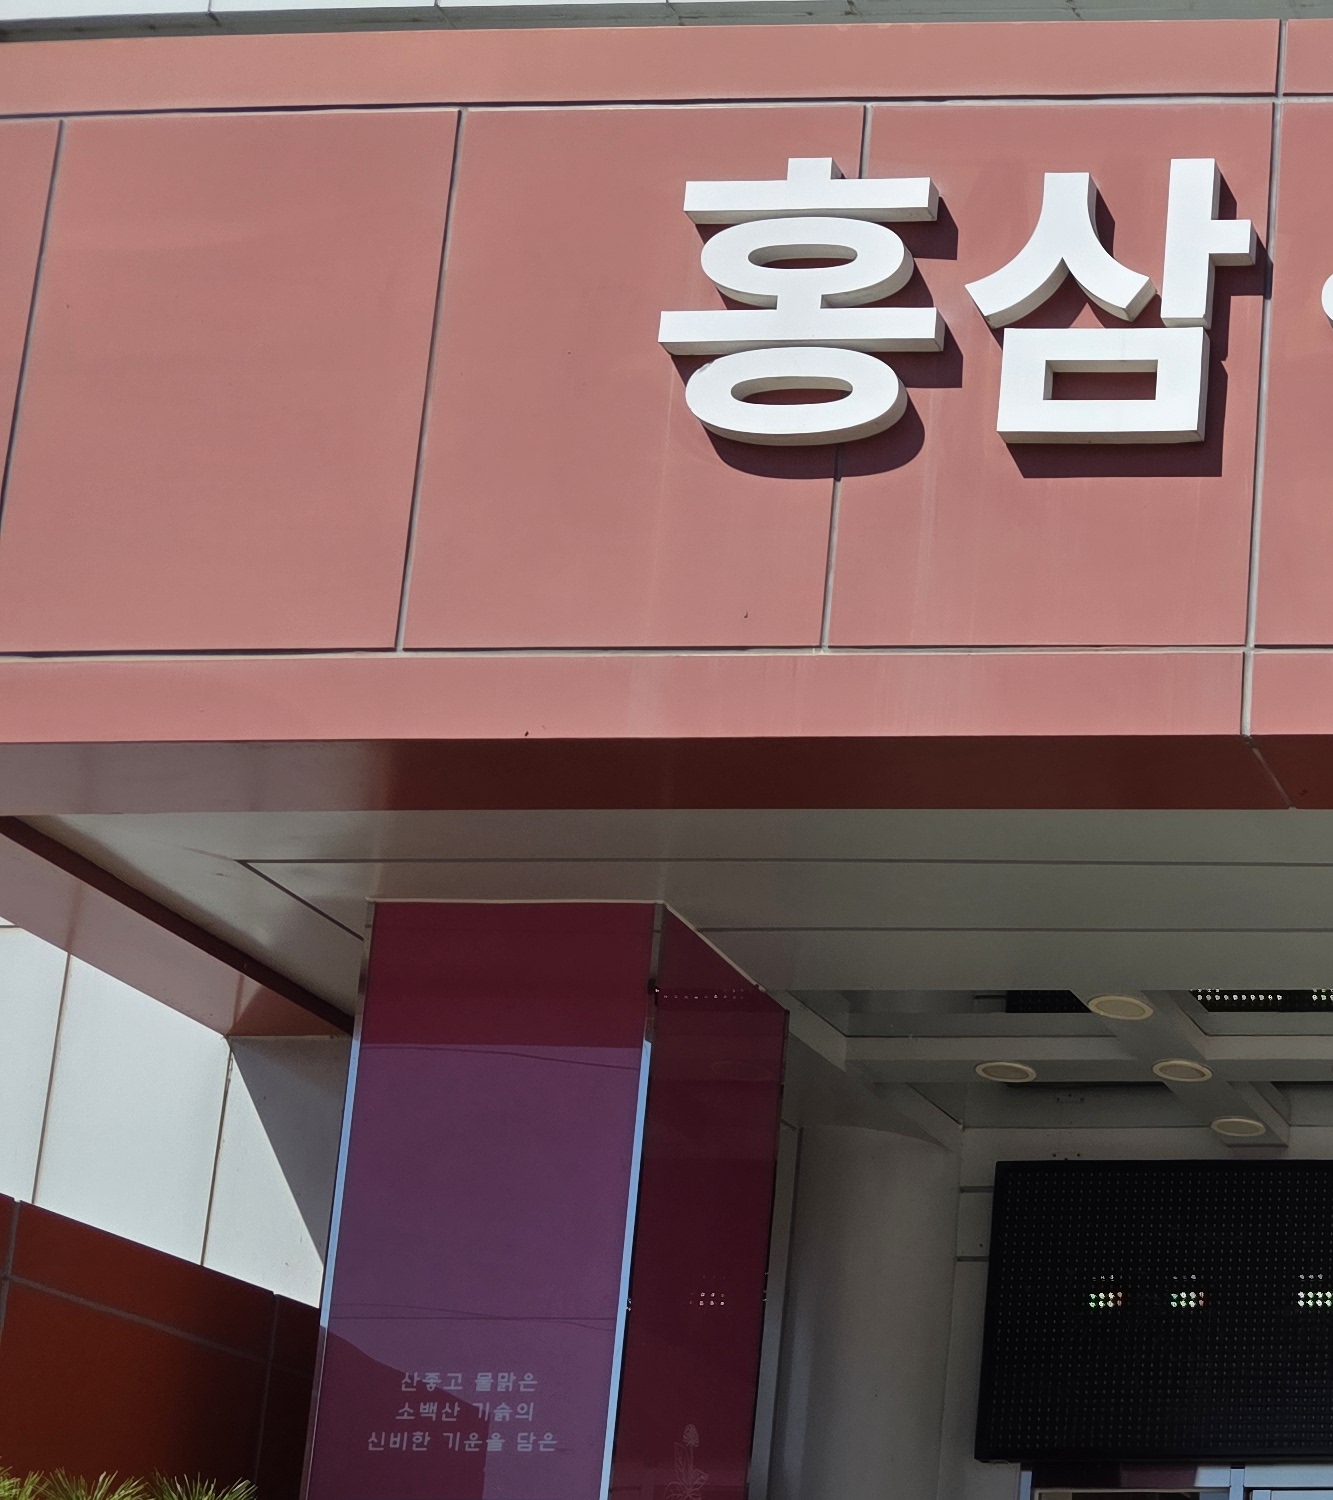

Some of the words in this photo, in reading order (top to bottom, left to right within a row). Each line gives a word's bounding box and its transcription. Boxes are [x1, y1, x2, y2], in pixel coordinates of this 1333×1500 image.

[400, 1371, 464, 1392] 산좋고
[474, 1371, 538, 1392] 물맑은
[395, 1401, 461, 1421] 소백산
[472, 1401, 534, 1422] 기슭의
[367, 1431, 431, 1451] 신비한
[443, 1431, 506, 1452] 기운을
[516, 1431, 558, 1452] 담은
